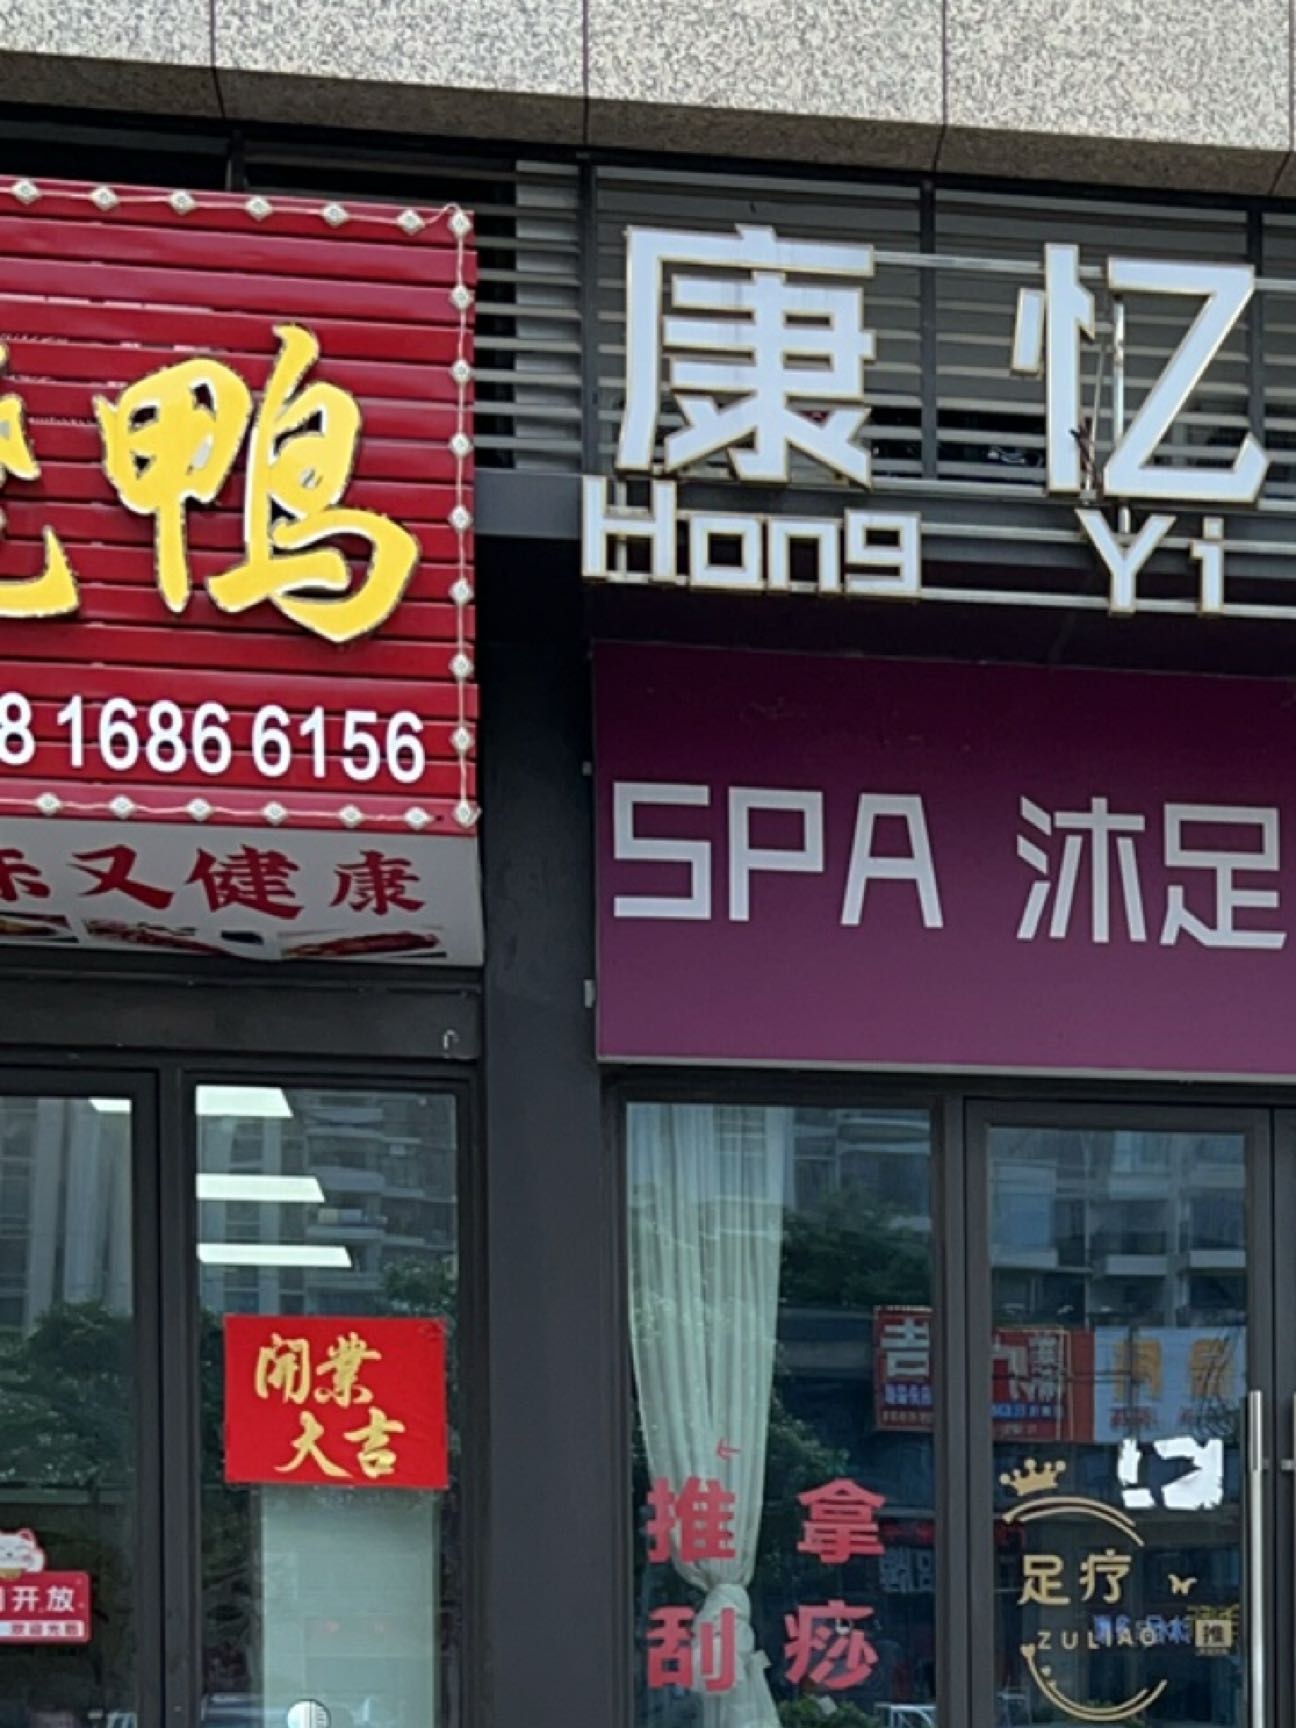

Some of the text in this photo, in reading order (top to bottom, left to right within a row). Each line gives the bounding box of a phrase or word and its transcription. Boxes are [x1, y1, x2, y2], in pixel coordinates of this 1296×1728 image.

[0, 320, 421, 643] 鸭
[581, 475, 922, 597] Hong
[1075, 508, 1224, 614] Yi
[56, 694, 231, 774] 1686
[252, 704, 426, 783] 6156
[613, 781, 944, 928] SPA
[1016, 796, 1287, 949] 沐足
[274, 1407, 405, 1479] 大吉
[647, 1476, 886, 1563] 推拿
[0, 1585, 75, 1612] 开放
[1018, 1549, 1133, 1605] 足疗
[646, 1600, 877, 1692] 刮痧
[1037, 1631, 1156, 1650] ZULIAO
